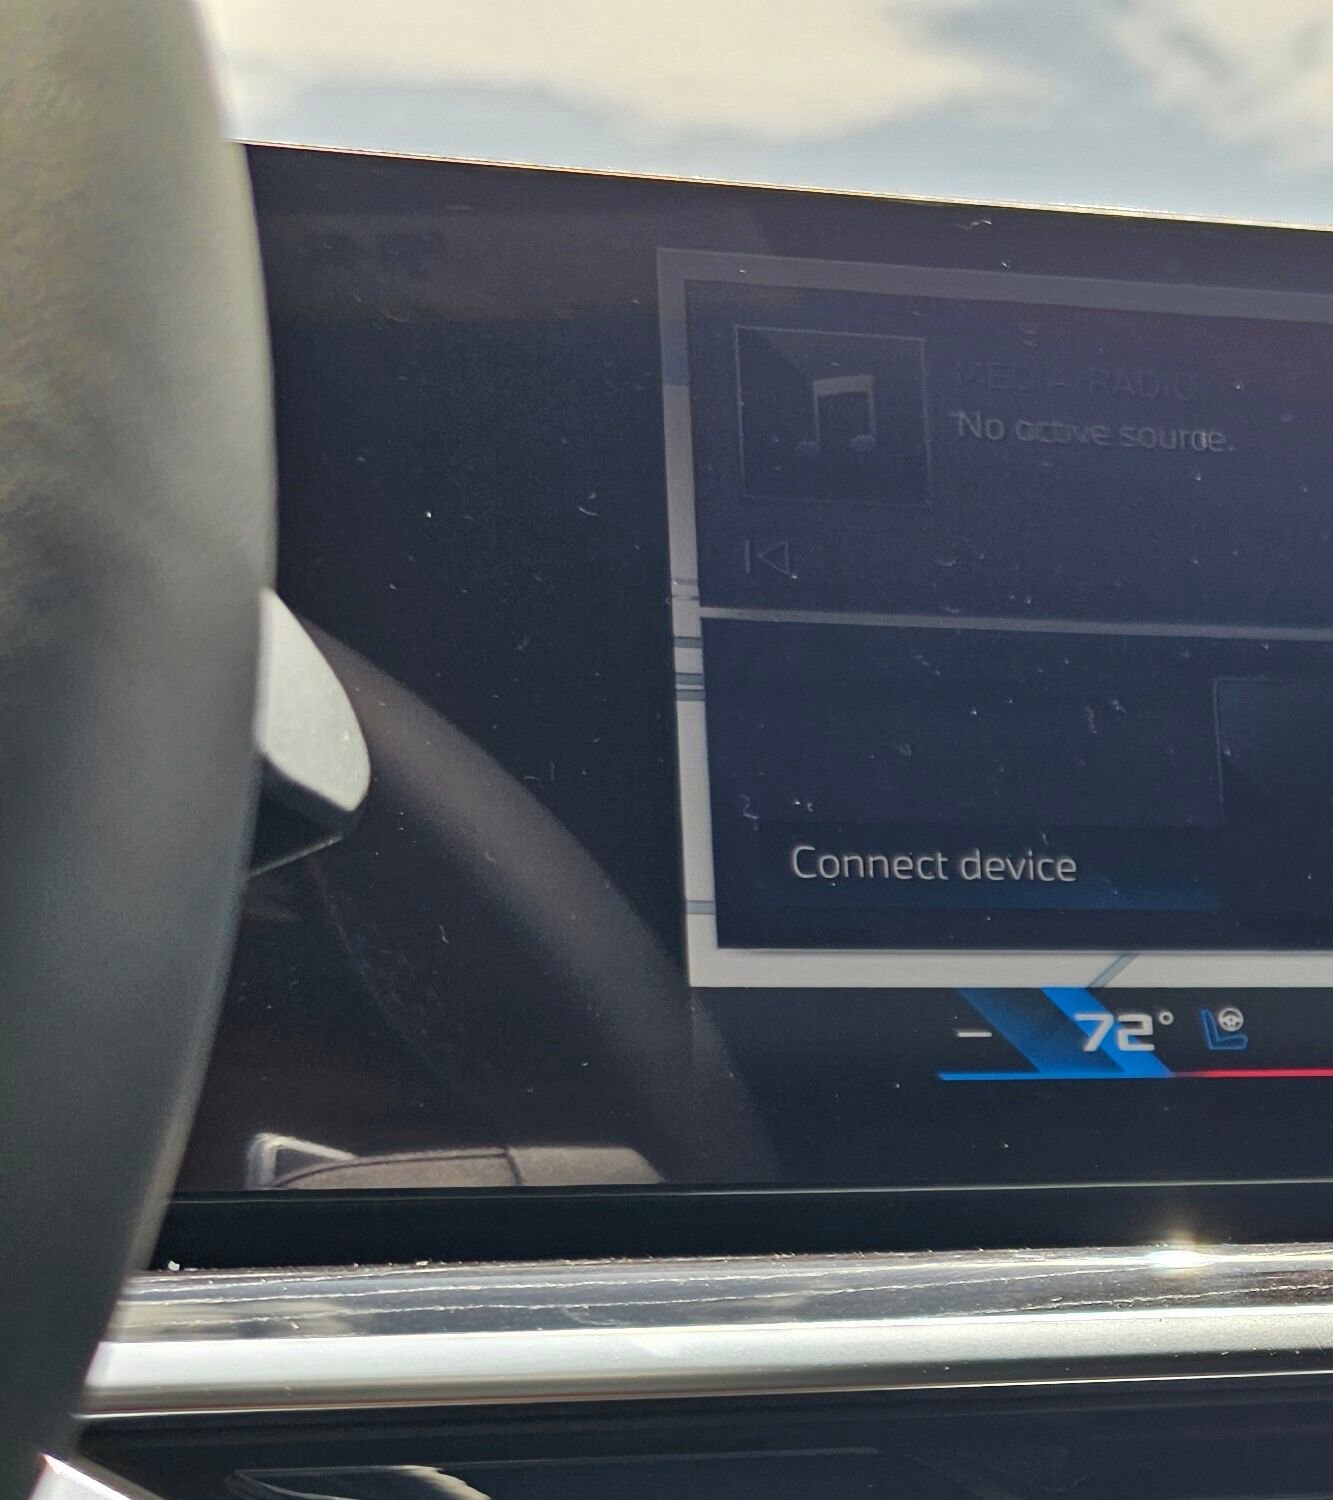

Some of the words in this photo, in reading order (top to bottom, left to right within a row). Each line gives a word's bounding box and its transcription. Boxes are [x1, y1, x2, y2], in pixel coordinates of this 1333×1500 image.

[956, 411, 1006, 441] No
[1119, 424, 1237, 452] source.
[792, 844, 949, 881] Connect
[960, 848, 1078, 882] device
